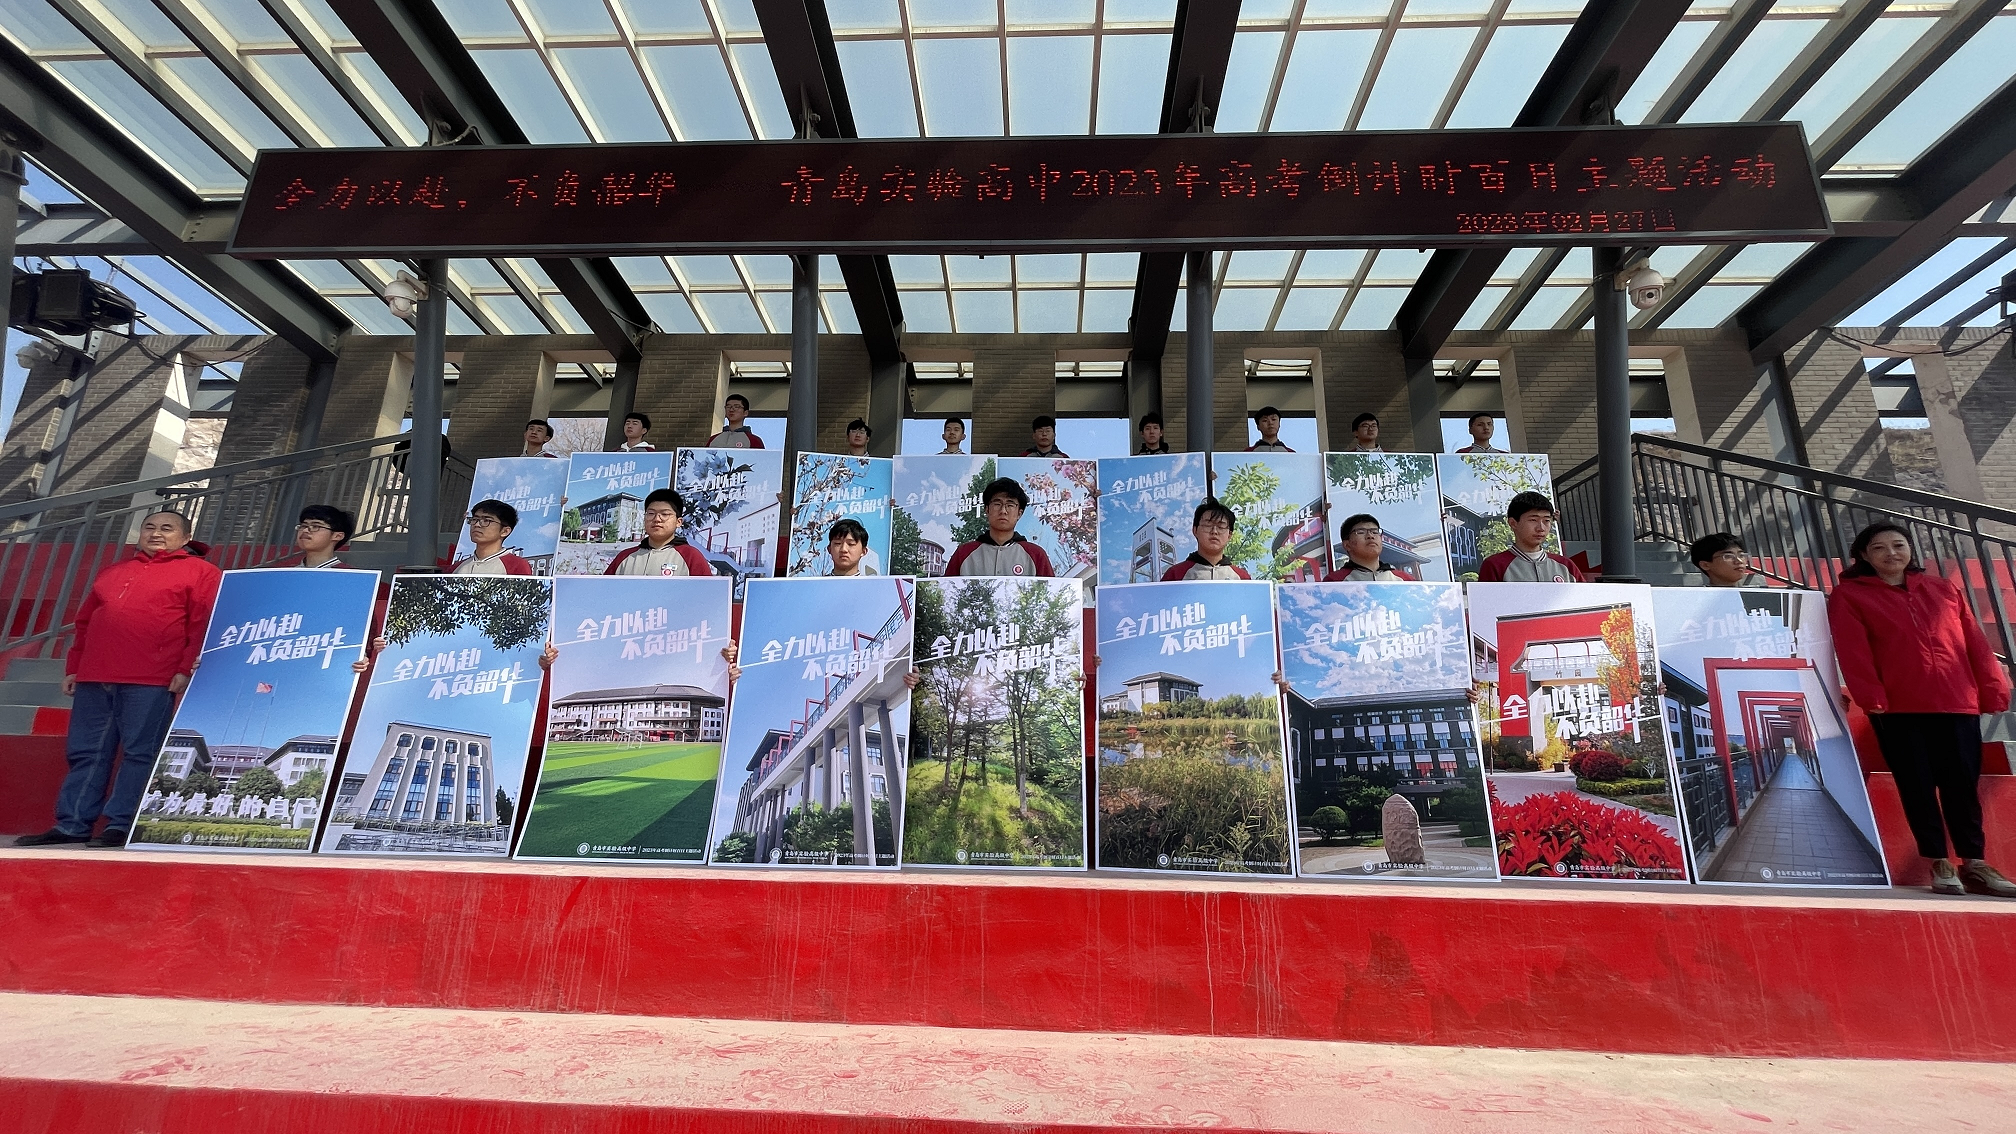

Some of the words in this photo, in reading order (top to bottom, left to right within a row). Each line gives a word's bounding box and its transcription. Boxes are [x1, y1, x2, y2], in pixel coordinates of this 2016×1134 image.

[583, 461, 636, 480] 全力以赴
[606, 467, 660, 492] 不负韶华
[1112, 471, 1166, 494] 全力以赴
[1342, 472, 1397, 491] 全力以赴
[503, 494, 556, 517] 负韶华
[809, 486, 865, 503] 全力以赴
[906, 485, 959, 505] 全力以赴
[931, 492, 985, 518] 不负韶华
[1139, 477, 1196, 503] 不负韶华
[1370, 479, 1424, 505] 不负韶华
[835, 494, 889, 520] 不负韶华
[1034, 494, 1088, 520] 不负韶华
[1230, 498, 1286, 518] 全力以赴
[1258, 507, 1313, 532] 不负韶华
[219, 613, 302, 647] 全力以赴
[577, 607, 667, 641] 全力以赴
[1116, 602, 1206, 638] 全力以赴
[1160, 615, 1252, 658] 不负韶华
[1305, 610, 1402, 646] 全力以赴
[1679, 608, 1773, 642] 全力以赴
[246, 627, 346, 669] 不负韶华
[620, 620, 712, 663] 不负韶华
[761, 628, 850, 662] 全力以赴
[930, 624, 1020, 657] 全力以赴
[1354, 621, 1451, 667] 不负韶华
[1733, 626, 1816, 666] 不负韶华
[392, 648, 482, 681] 全力以赴
[802, 640, 894, 683] 不负韶华
[973, 637, 1064, 687] 不负韶华
[427, 662, 523, 704] 不负韶华
[1503, 683, 1600, 718] 全力以赴
[1552, 697, 1644, 744] 不负韶华
